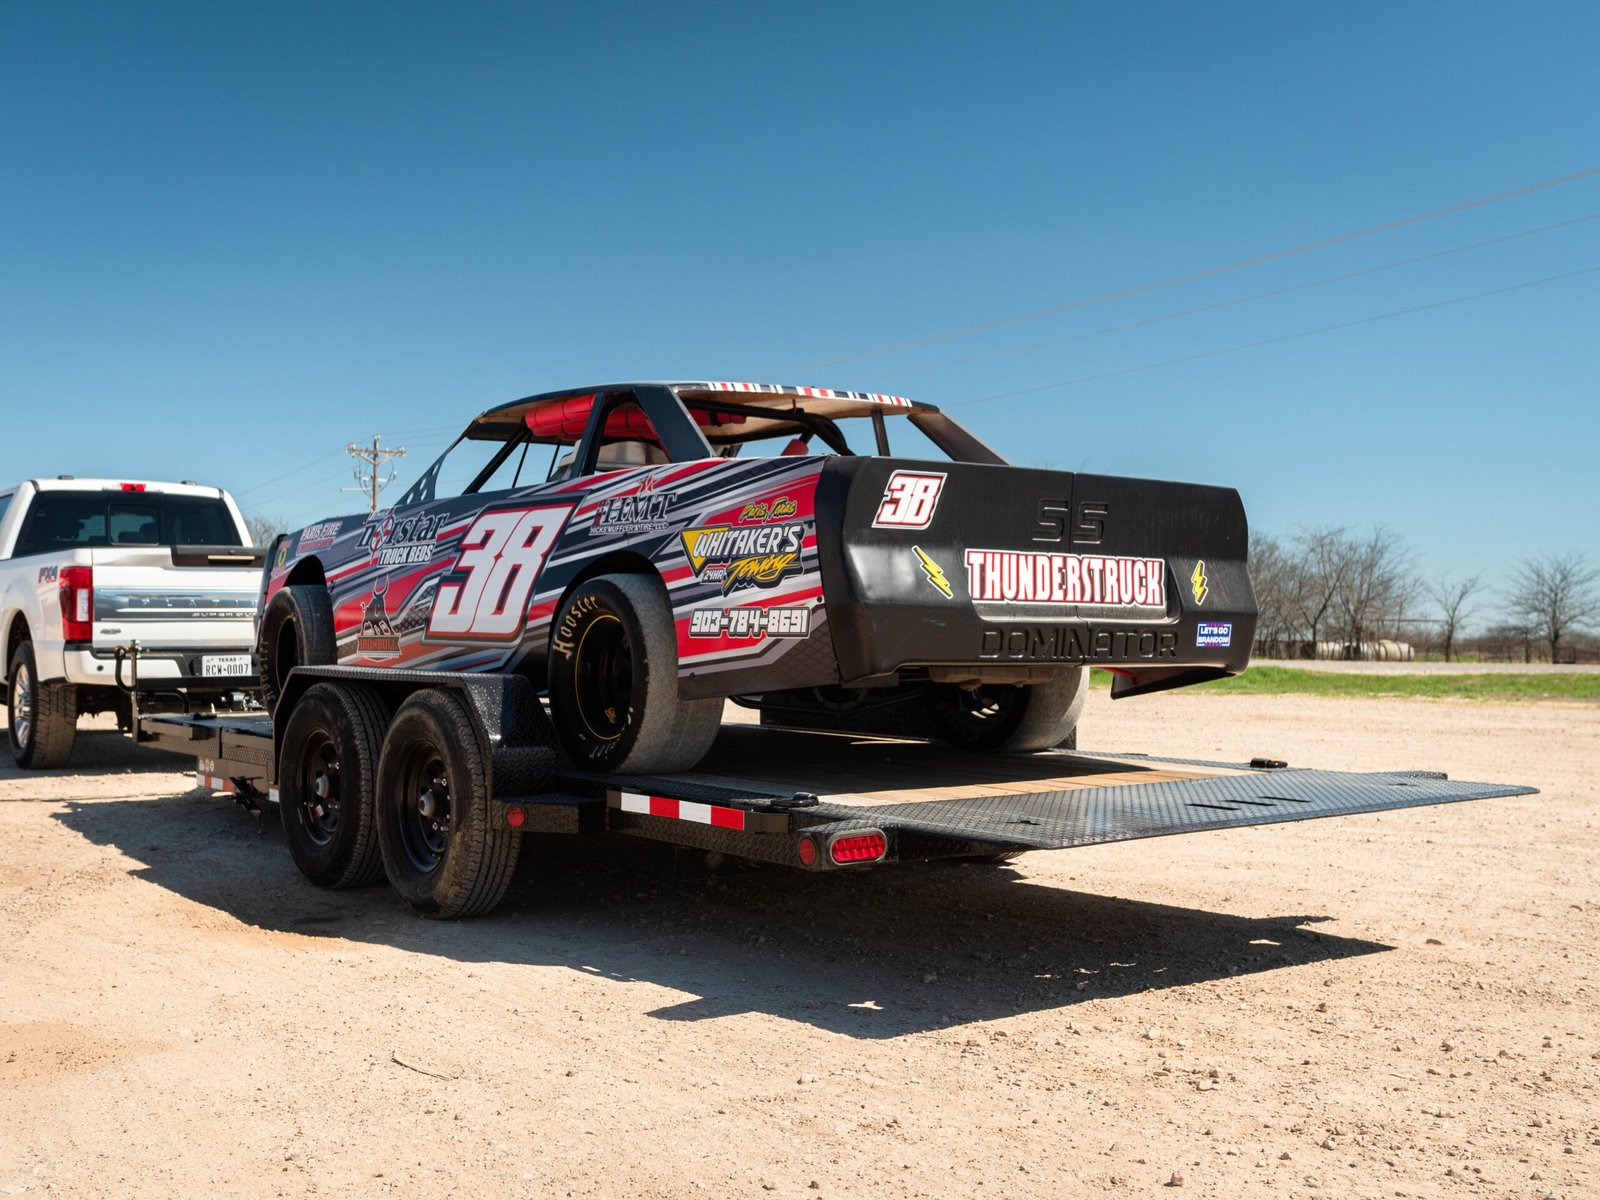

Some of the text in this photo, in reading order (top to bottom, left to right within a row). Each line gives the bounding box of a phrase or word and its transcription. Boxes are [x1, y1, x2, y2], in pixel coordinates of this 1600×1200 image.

[602, 491, 678, 524] HMT
[873, 473, 944, 529] 38
[301, 522, 341, 541] PARIS FIRE
[693, 526, 801, 557] WHITAKER'S
[380, 543, 433, 565] TRUCK BEDS
[428, 503, 576, 637] 38
[703, 569, 724, 581] 24HR
[724, 553, 800, 590] Towing
[967, 551, 1164, 606] THUNDERSTRUCK
[690, 608, 809, 634] 903-784-8691
[1200, 626, 1229, 634] LET'S GO
[978, 626, 1178, 659] DOMINATOR
